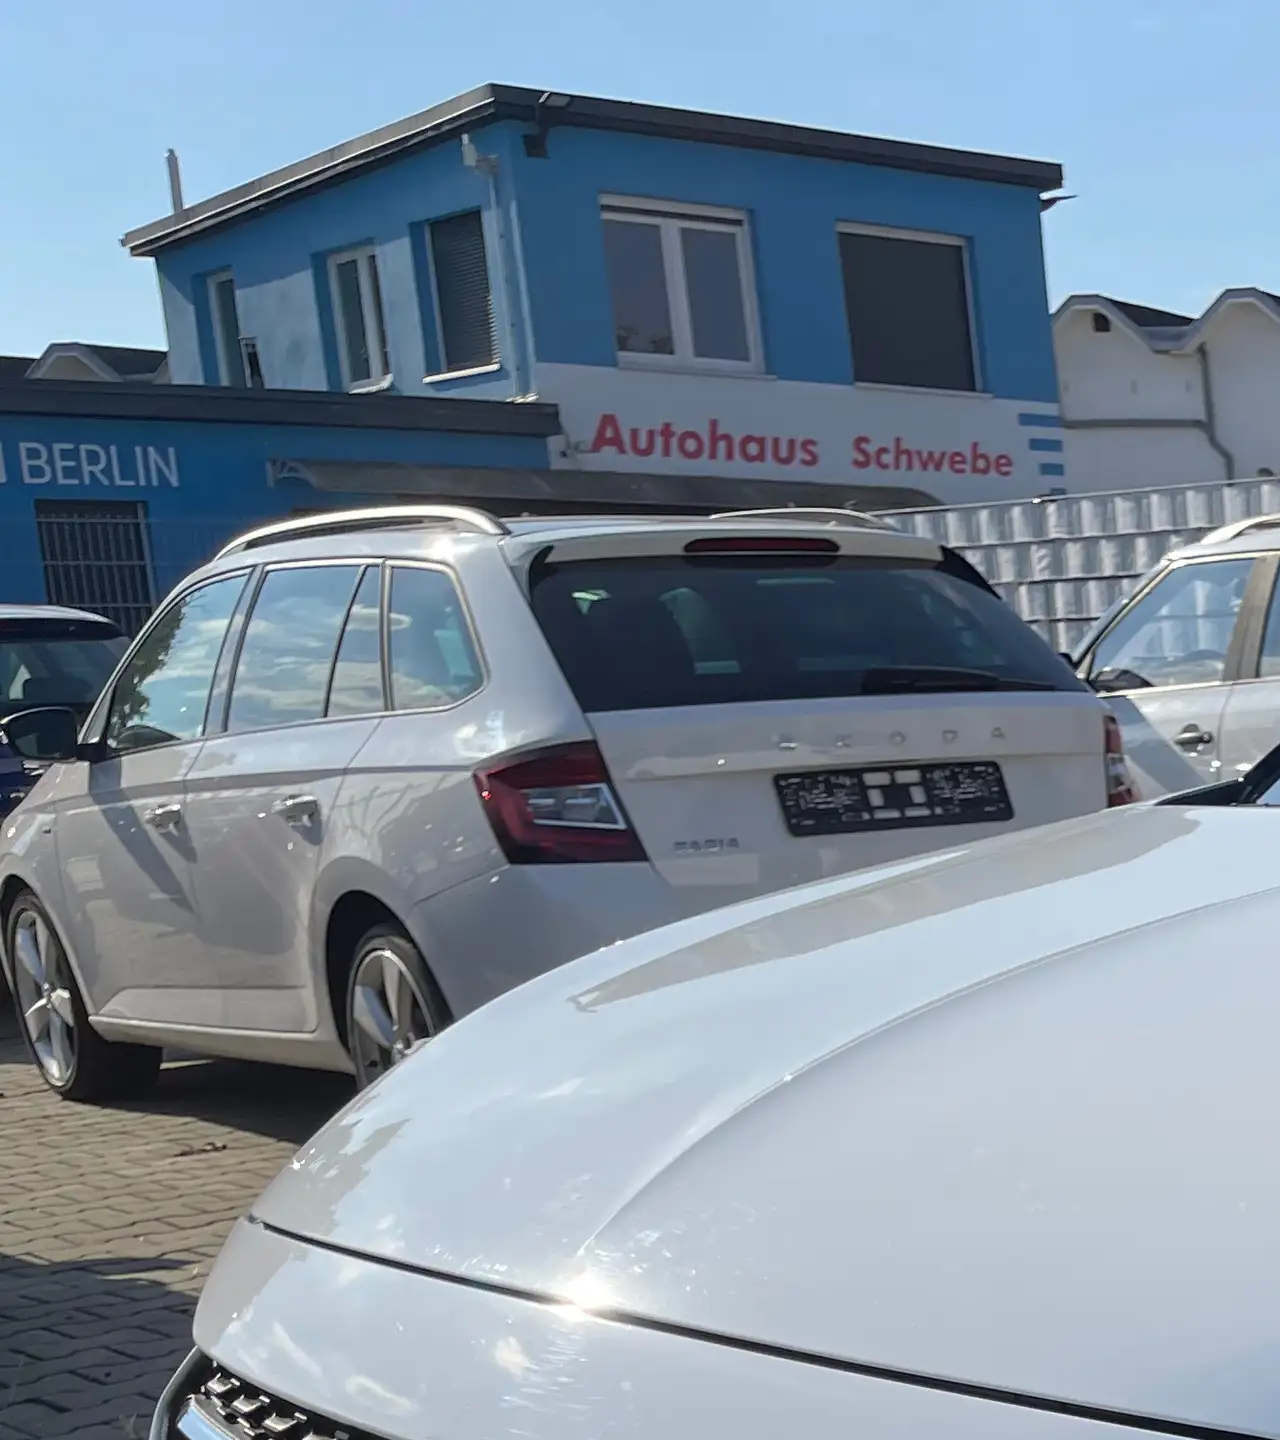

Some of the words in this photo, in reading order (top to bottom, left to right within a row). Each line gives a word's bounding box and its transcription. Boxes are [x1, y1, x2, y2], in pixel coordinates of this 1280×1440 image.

[18, 441, 180, 487] BERLIN
[592, 413, 819, 467] Autohaus
[851, 435, 1014, 476] Schwebe
